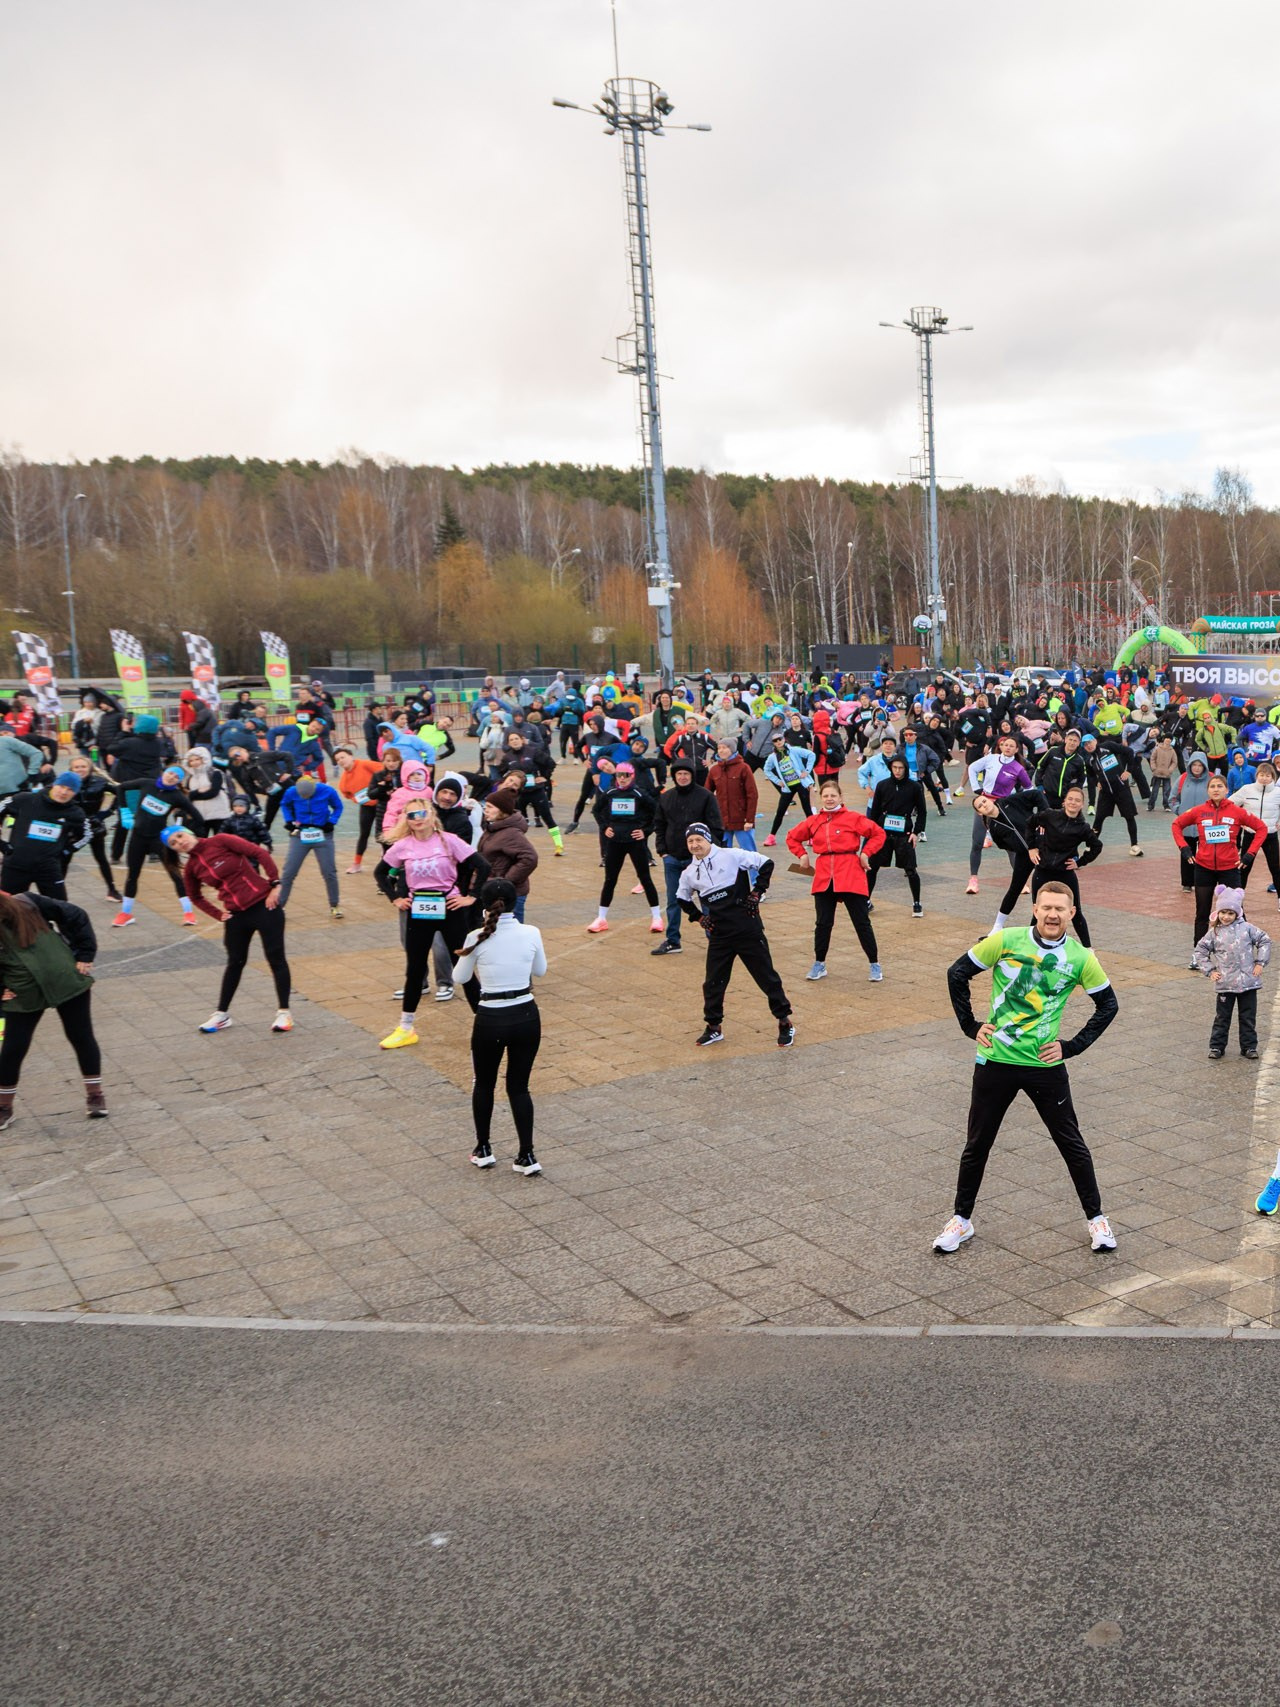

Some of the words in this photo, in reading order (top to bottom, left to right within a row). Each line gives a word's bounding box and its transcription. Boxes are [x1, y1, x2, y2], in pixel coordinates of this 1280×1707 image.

[1210, 620, 1247, 631] МАЙСКАЯ
[1250, 620, 1276, 630] ГРОЗА
[1172, 667, 1222, 684] ТВОЯ
[38, 827, 52, 835] 192
[1208, 830, 1226, 838] 1020
[708, 891, 728, 903] adidas
[419, 904, 437, 912] 554
